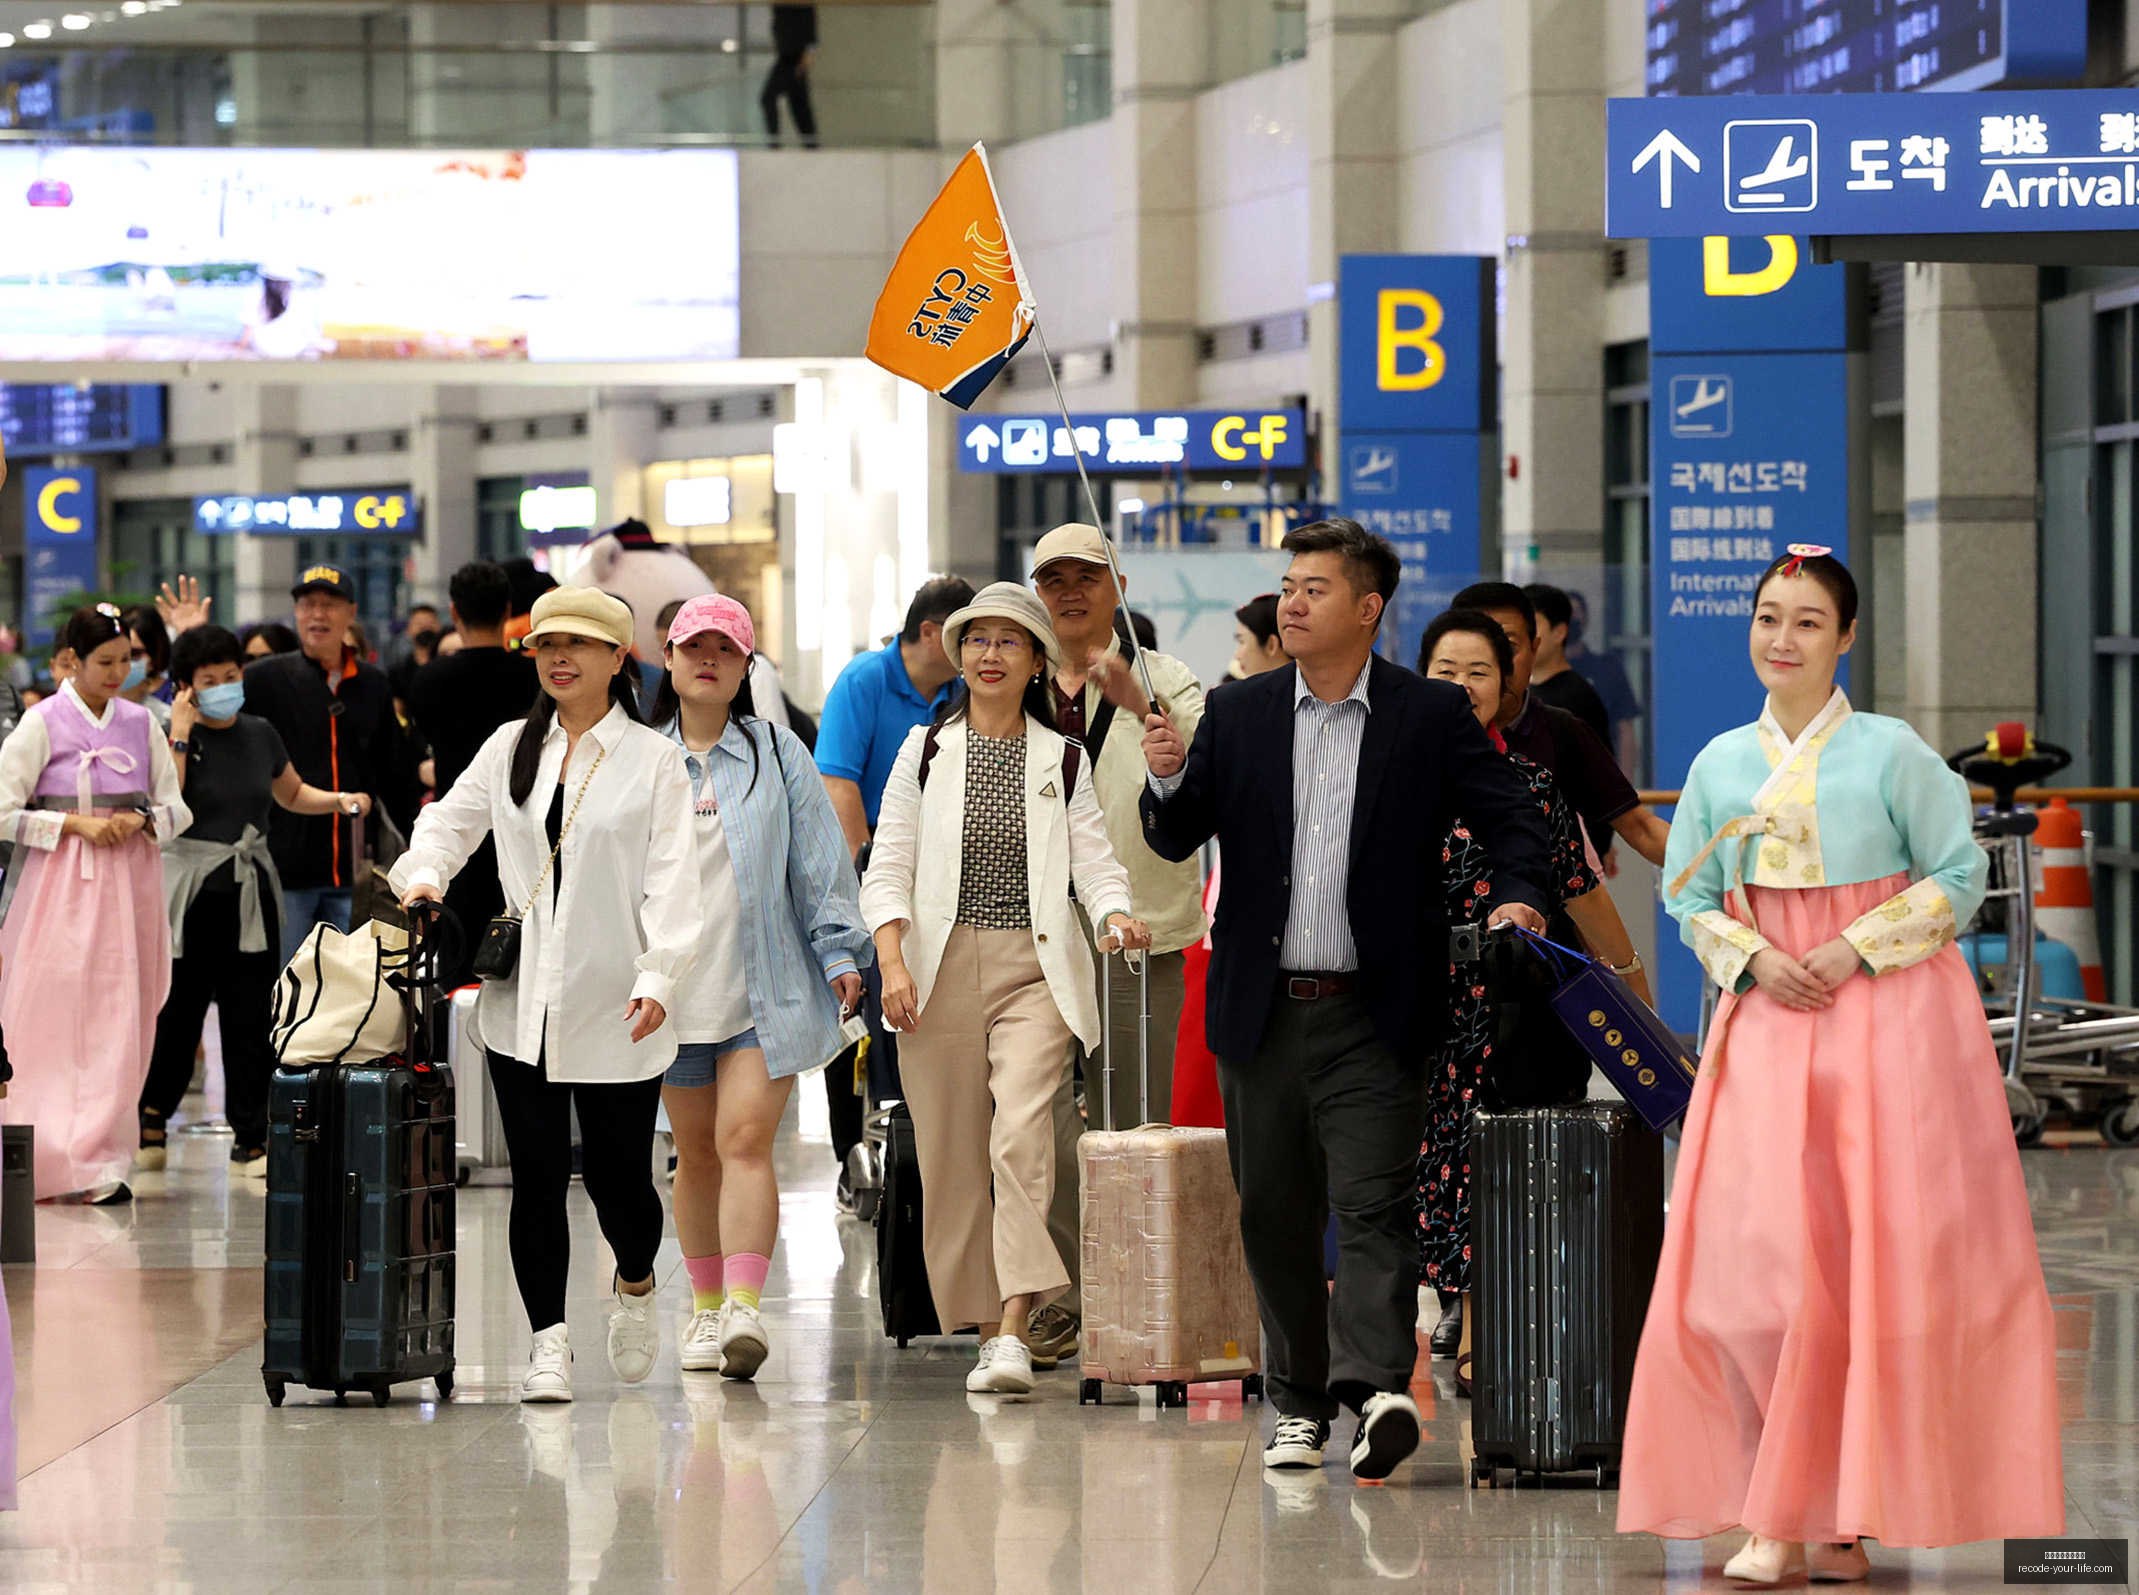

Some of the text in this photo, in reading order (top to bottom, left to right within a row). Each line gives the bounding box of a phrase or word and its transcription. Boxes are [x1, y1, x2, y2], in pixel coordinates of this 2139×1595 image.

[1846, 134, 1950, 192] 도착
[1980, 163, 2139, 209] Arrival
[1376, 289, 1446, 392] B
[1211, 415, 1288, 461] C-F
[1670, 460, 1807, 493] 국제선도착
[37, 478, 81, 534] C
[1670, 571, 1764, 592] Internat
